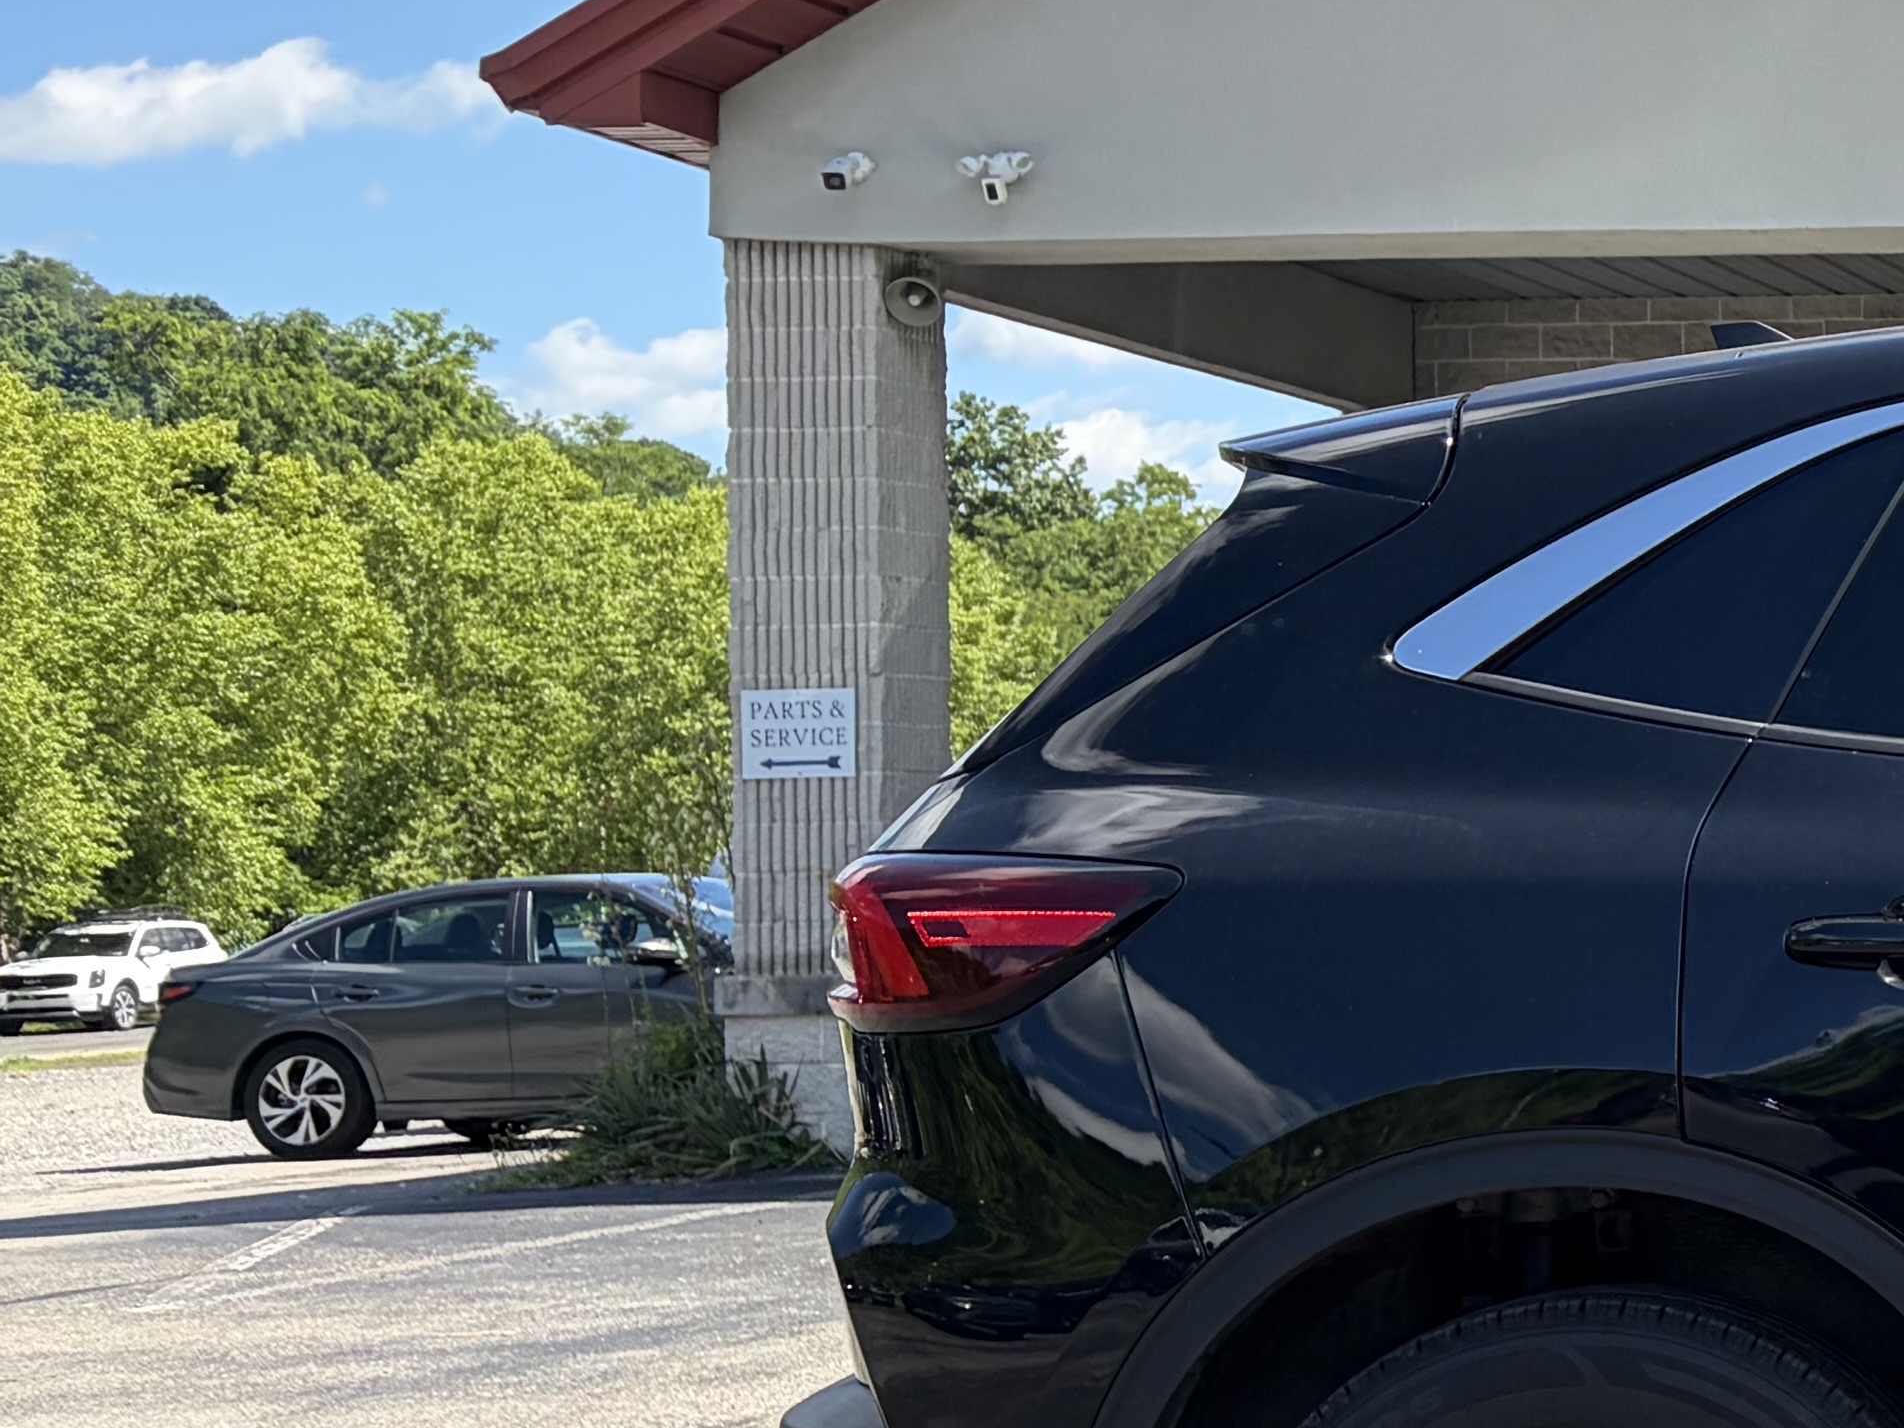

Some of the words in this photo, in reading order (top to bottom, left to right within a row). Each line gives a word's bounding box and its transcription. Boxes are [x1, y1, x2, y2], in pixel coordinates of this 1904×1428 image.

[750, 700, 822, 720] PARTS
[830, 699, 845, 719] &
[750, 727, 847, 748] SERVICE
